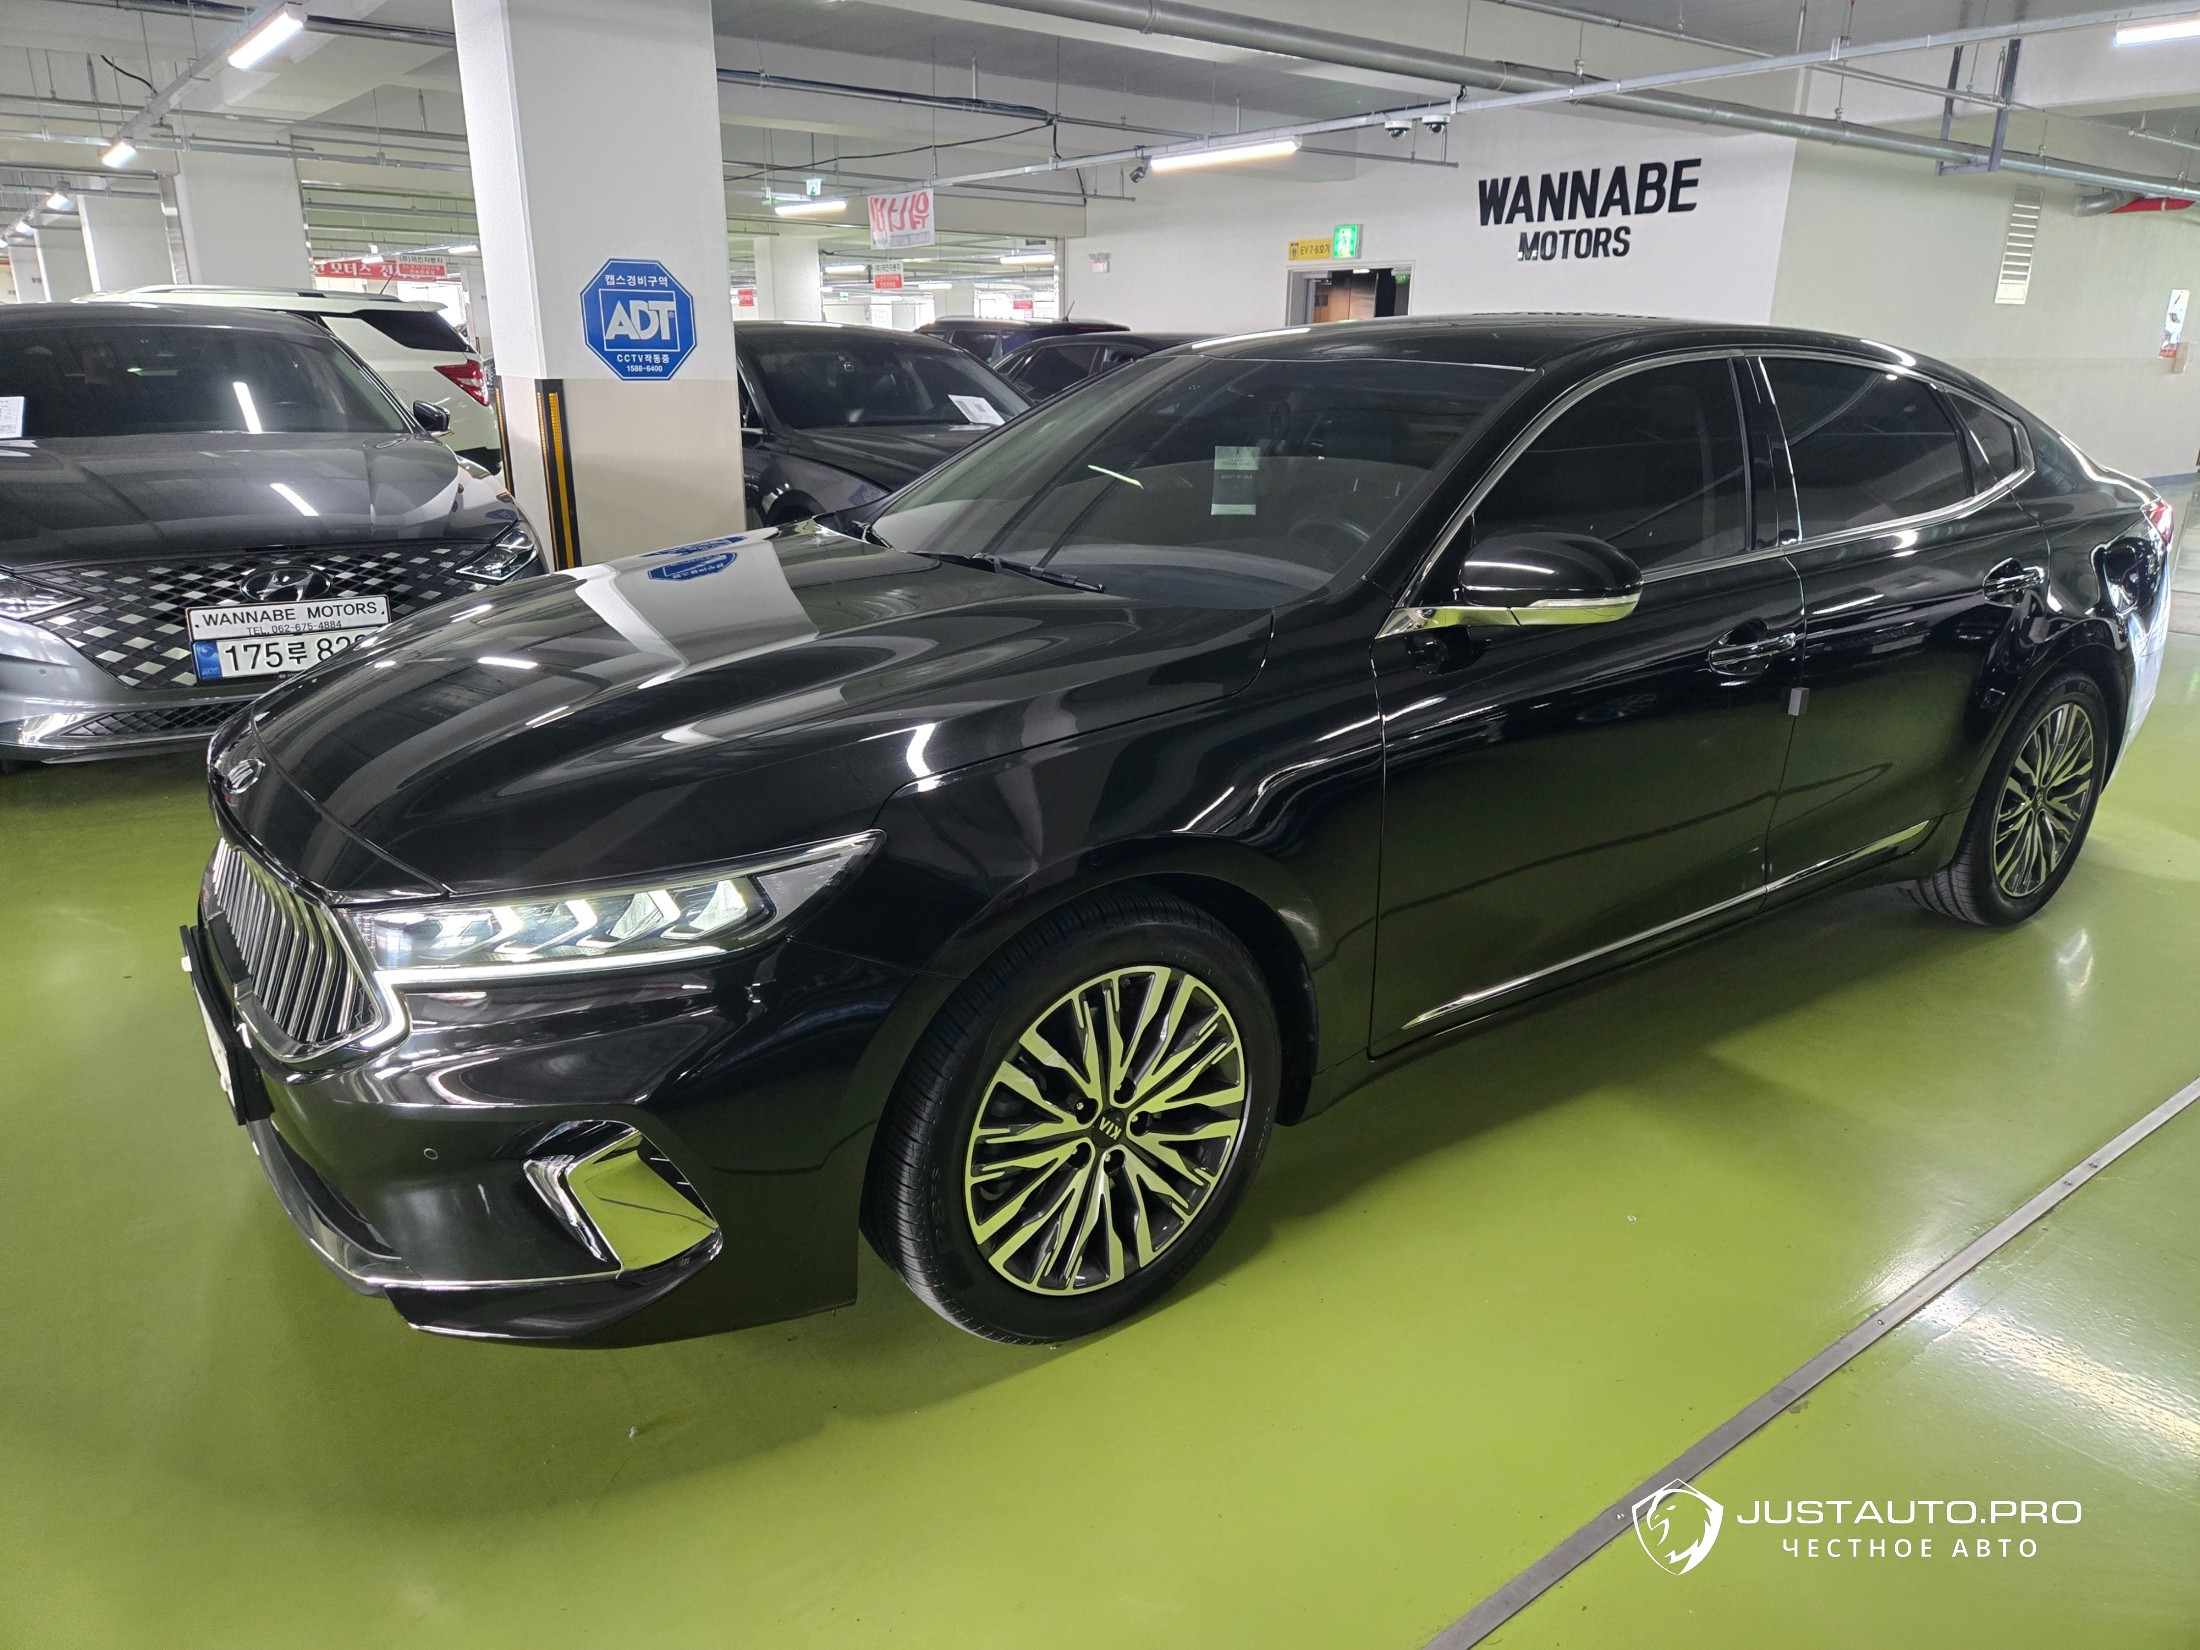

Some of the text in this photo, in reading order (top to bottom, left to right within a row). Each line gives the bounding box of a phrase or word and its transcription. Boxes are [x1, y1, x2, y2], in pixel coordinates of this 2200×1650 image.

[1478, 158, 1702, 226] WANNABE
[1517, 225, 1631, 262] MOTORS
[605, 274, 668, 287] 캡스경비구역
[605, 299, 676, 340] ADT
[617, 354, 670, 364] CCTV작동중
[626, 364, 663, 372] 1588-6400
[202, 601, 377, 627] WANNABE MOTORS
